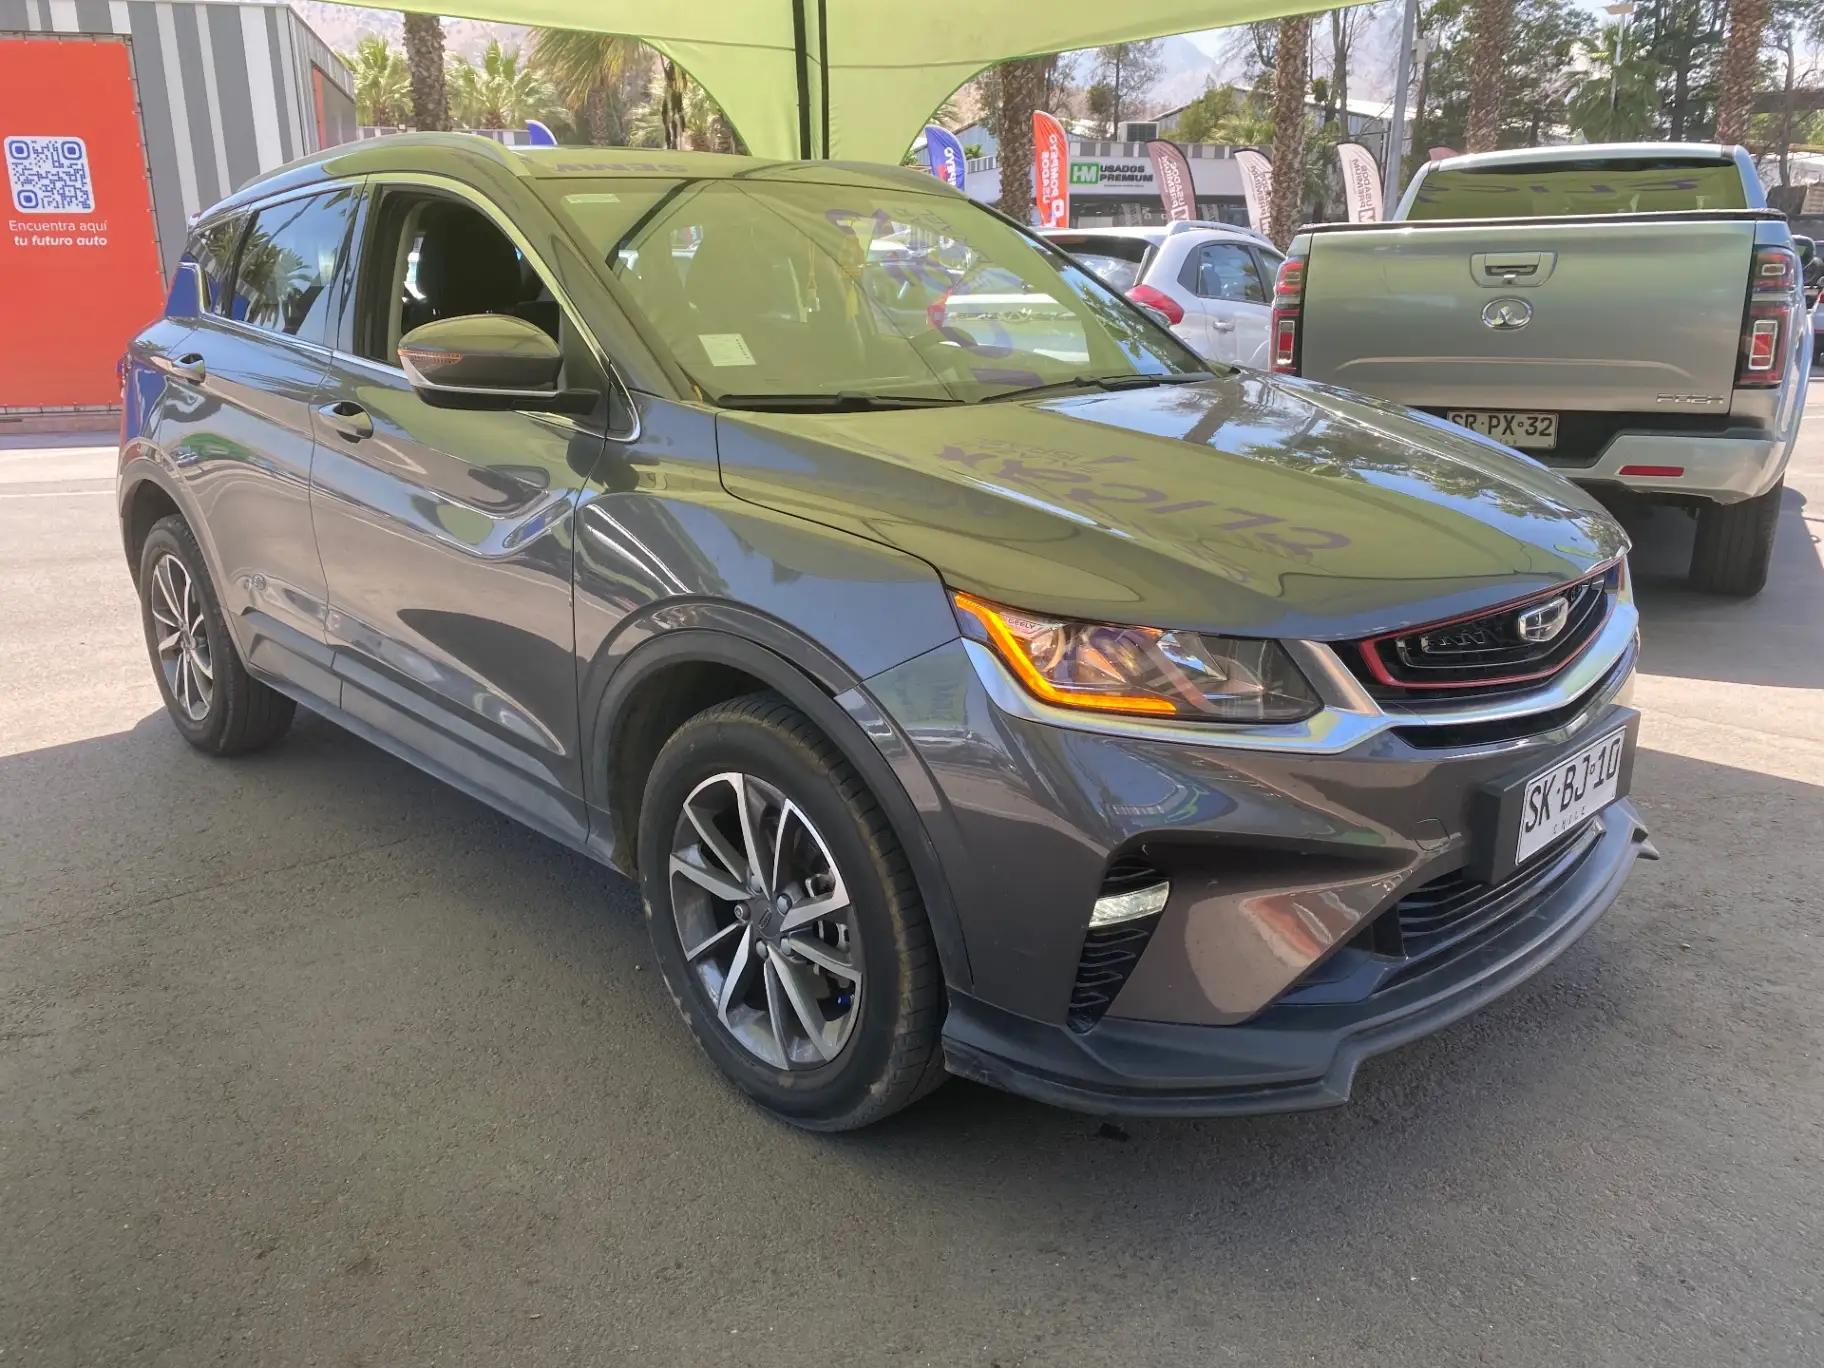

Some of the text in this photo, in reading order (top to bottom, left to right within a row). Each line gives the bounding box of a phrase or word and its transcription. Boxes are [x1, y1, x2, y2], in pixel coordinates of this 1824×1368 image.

[1072, 164, 1146, 183] HM USADOS
[1100, 174, 1154, 183] PREMIUM
[8, 219, 108, 234] Encuentra aquí
[14, 234, 108, 247] tu futuro auto
